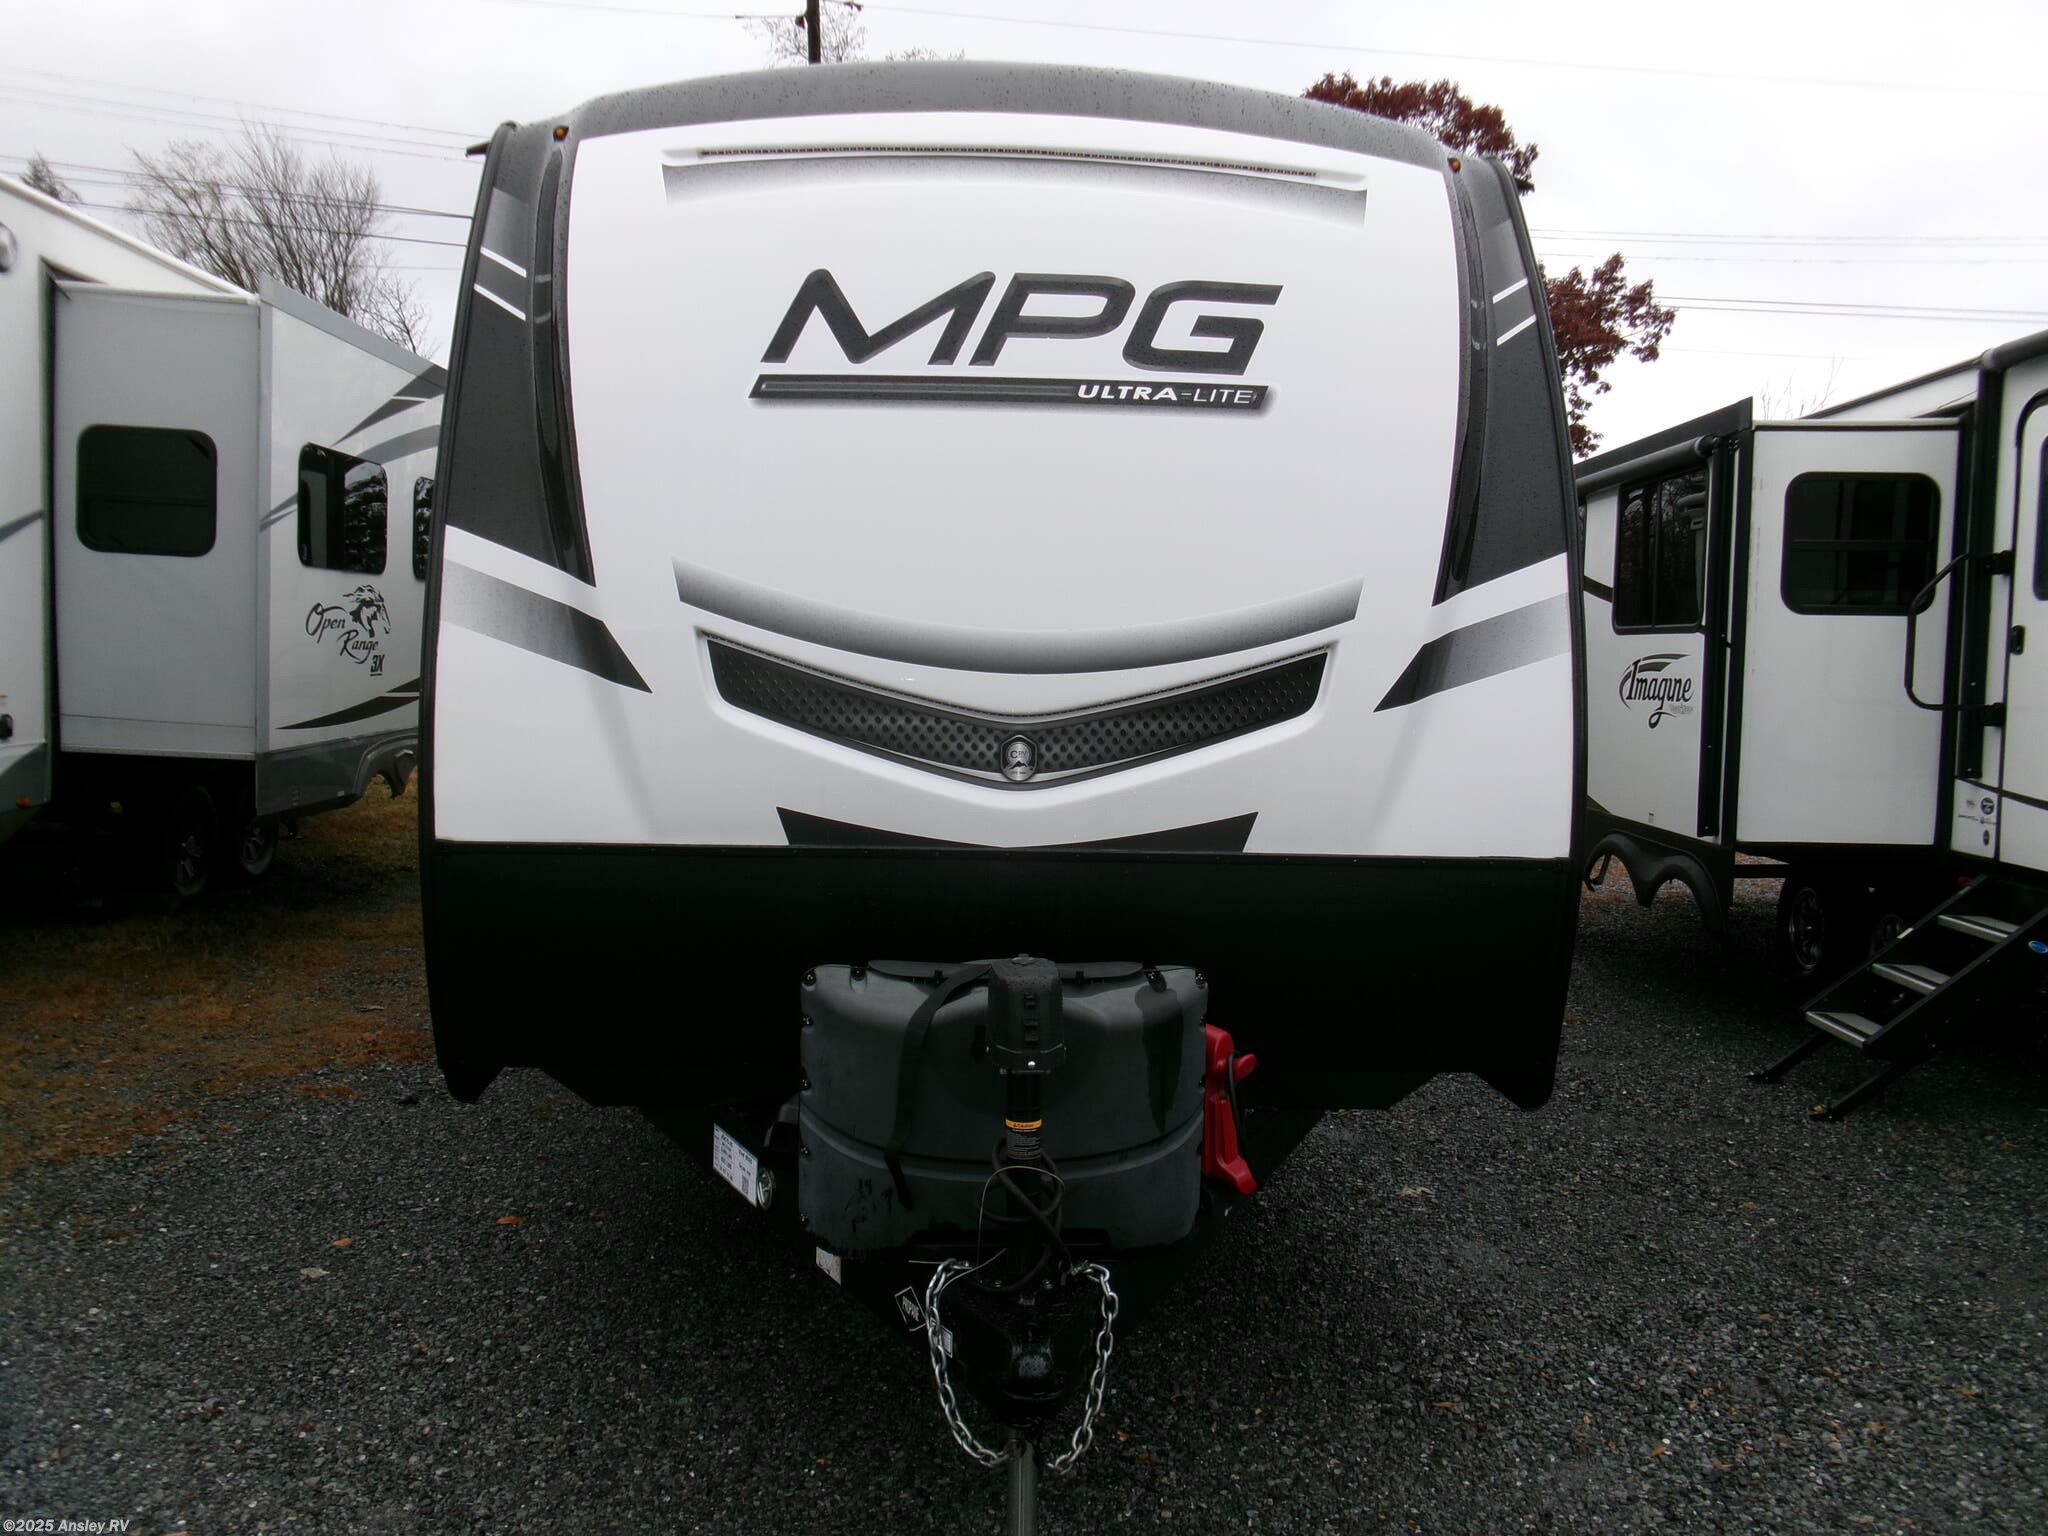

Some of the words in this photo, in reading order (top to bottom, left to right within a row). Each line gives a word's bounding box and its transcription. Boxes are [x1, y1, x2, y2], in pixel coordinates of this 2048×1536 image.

[760, 268, 1283, 376] MPG
[1077, 384, 1254, 404] ULTRA-LITE
[305, 602, 347, 645] Open
[337, 629, 379, 664] Range
[370, 654, 385, 673] 3X
[1625, 658, 1694, 729] Imagine
